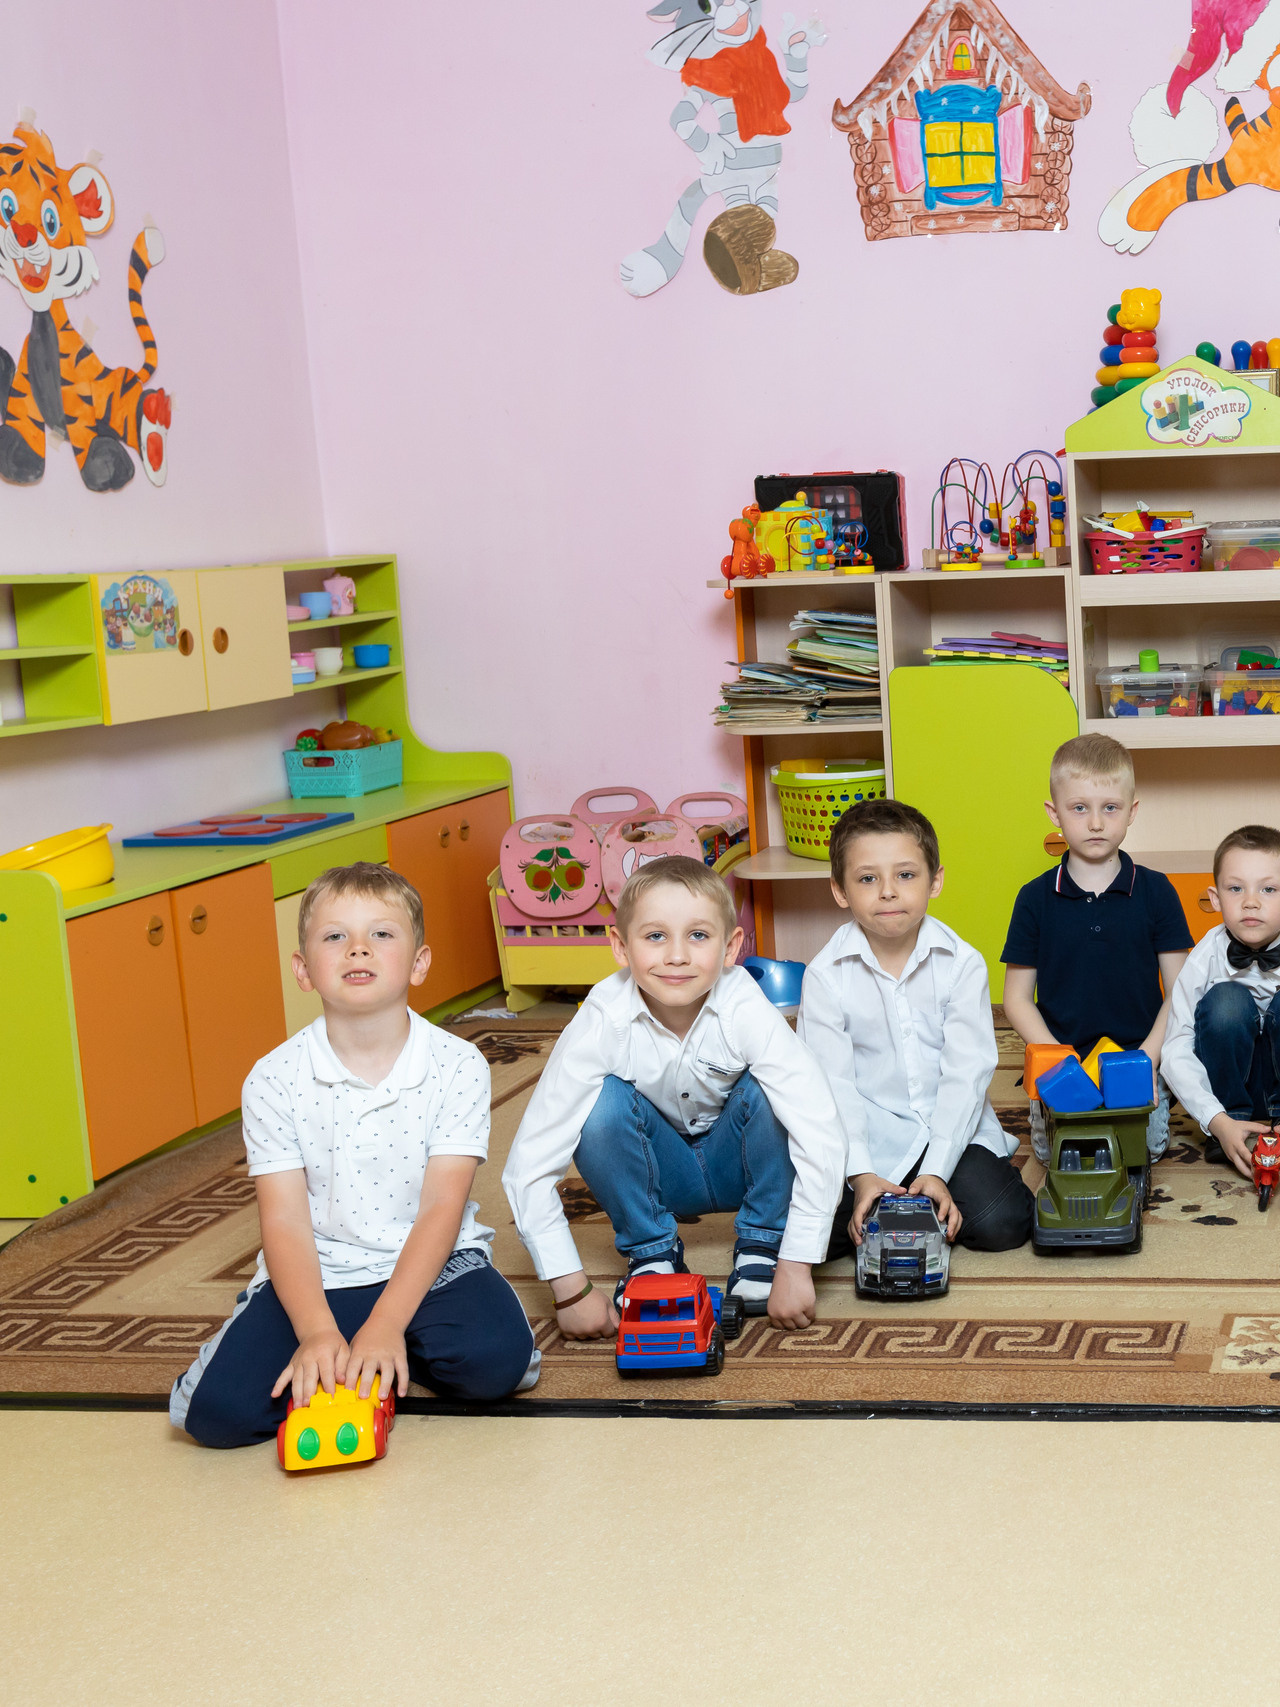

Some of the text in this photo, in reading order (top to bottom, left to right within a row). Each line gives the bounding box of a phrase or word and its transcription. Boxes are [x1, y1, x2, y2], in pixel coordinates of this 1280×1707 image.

[1166, 376, 1217, 397] УГОЛОК
[1186, 402, 1246, 443] СЕНСОРИКИ
[118, 579, 163, 603] КУХНЯ
